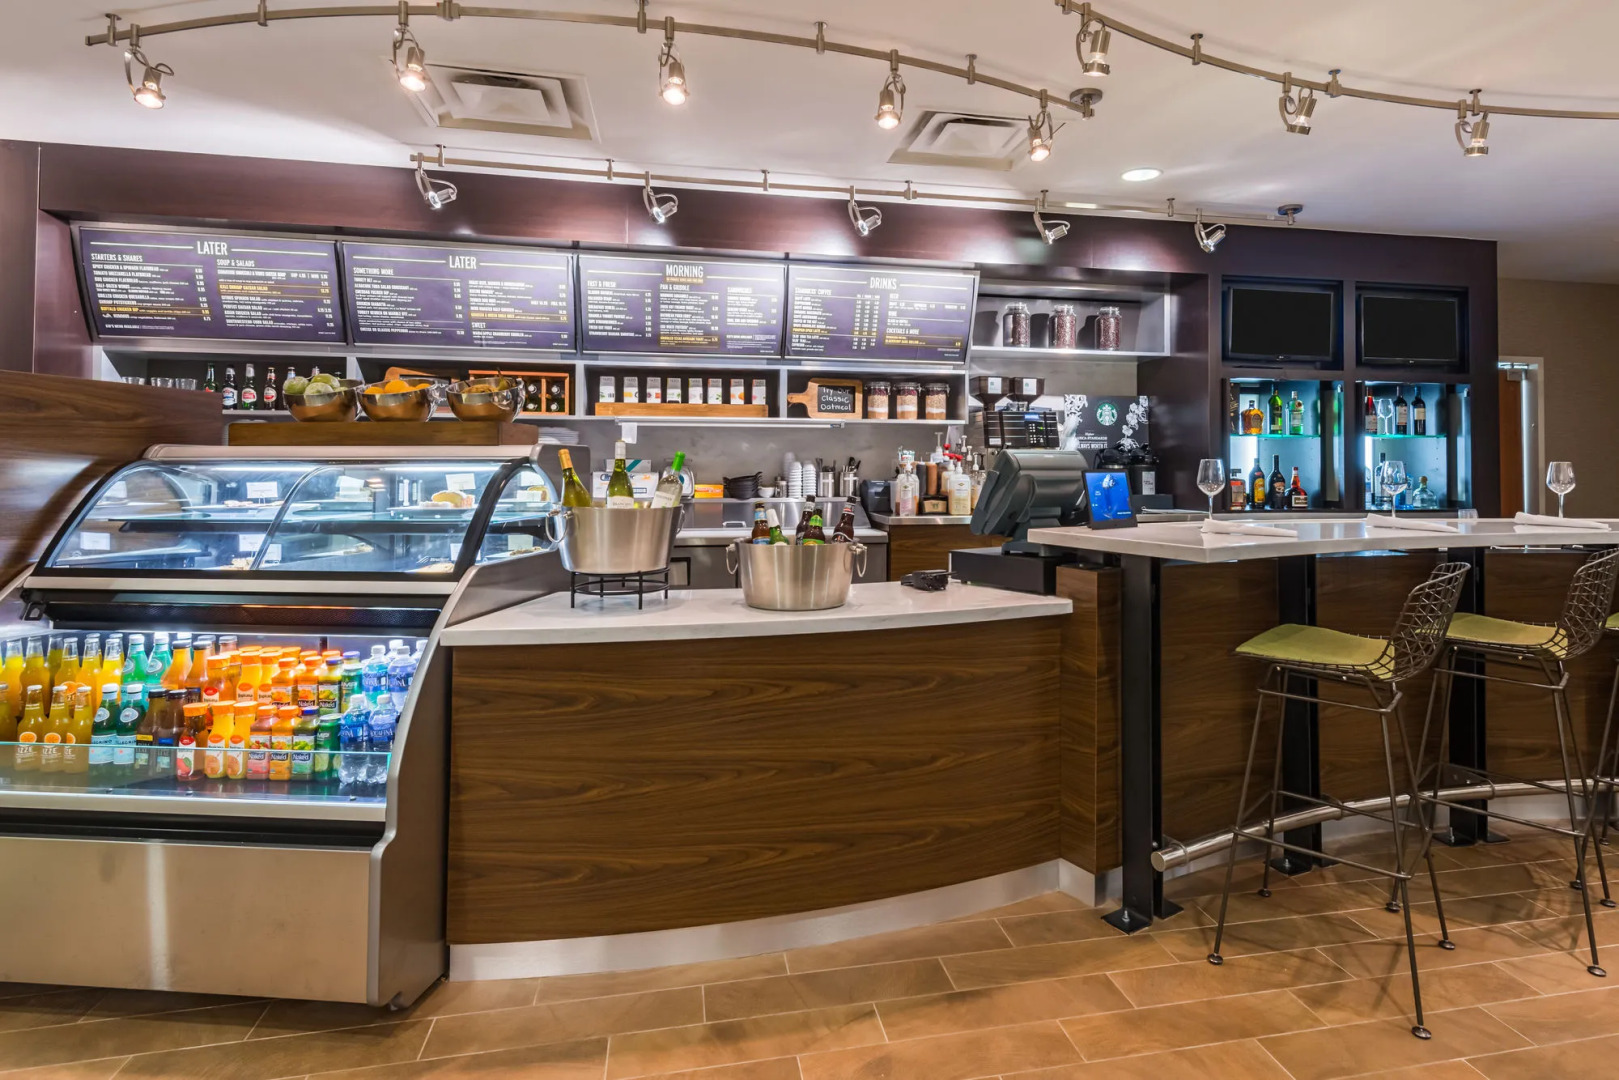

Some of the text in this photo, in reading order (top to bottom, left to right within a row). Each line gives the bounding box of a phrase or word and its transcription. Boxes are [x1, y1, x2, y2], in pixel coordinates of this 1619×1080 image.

[197, 241, 228, 256] LATER
[449, 255, 477, 270] LATER
[666, 264, 704, 278] MORNING
[870, 277, 897, 290] DRINKS
